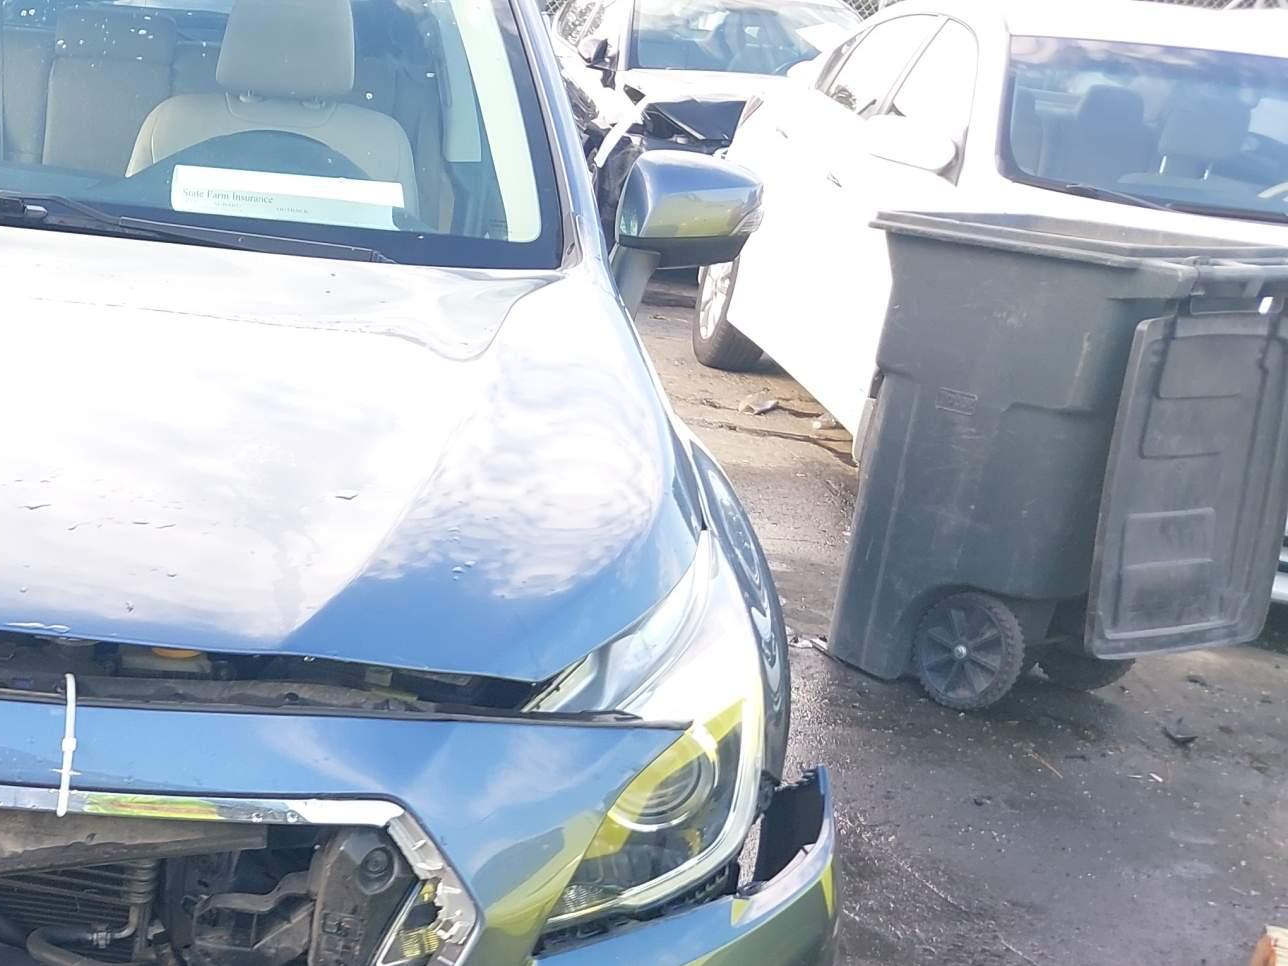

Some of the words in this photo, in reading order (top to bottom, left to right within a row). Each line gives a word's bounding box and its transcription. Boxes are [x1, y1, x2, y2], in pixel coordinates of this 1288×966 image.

[182, 188, 204, 199] State
[207, 189, 229, 201] Farm
[232, 191, 274, 204] Insurance
